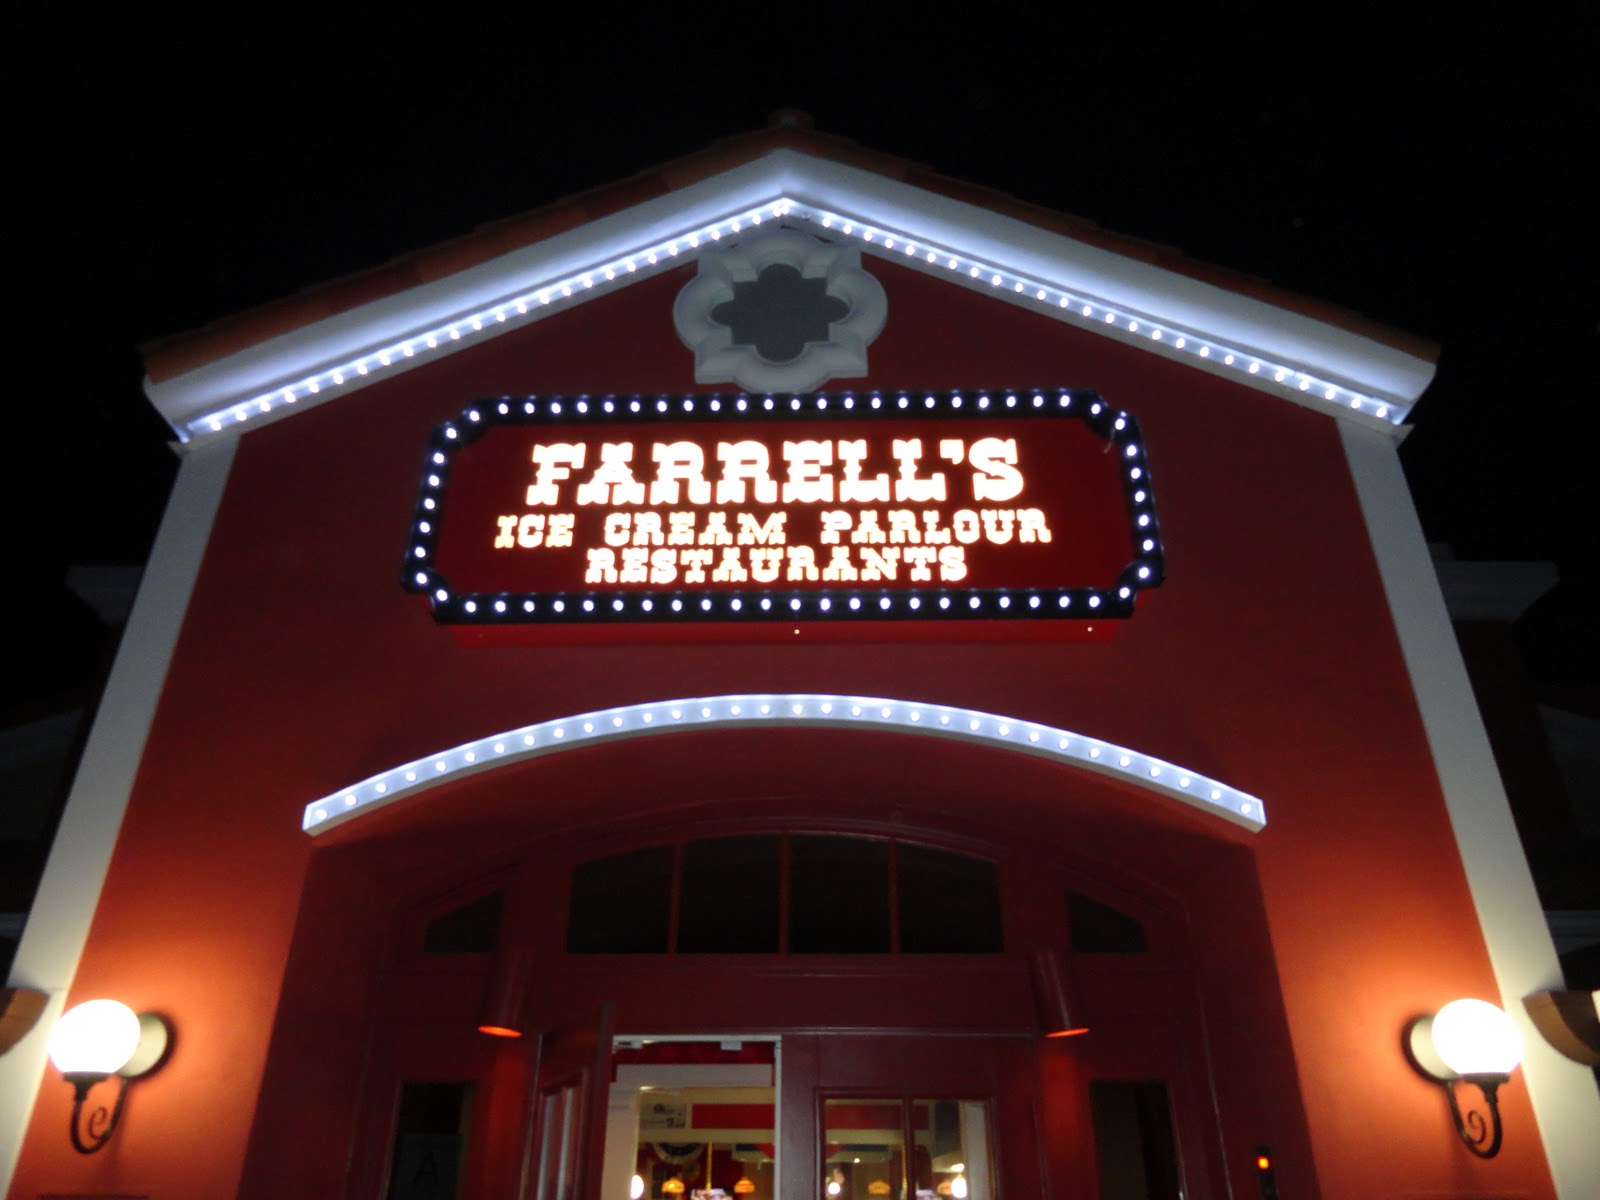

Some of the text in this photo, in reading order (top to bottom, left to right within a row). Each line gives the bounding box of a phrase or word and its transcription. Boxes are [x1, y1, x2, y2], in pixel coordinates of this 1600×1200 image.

[526, 437, 1024, 506] FARRELL'S
[495, 508, 1052, 548] ICE CREAM PARLOUR
[585, 545, 967, 584] RESTAURANTS
[413, 1152, 440, 1186] A
